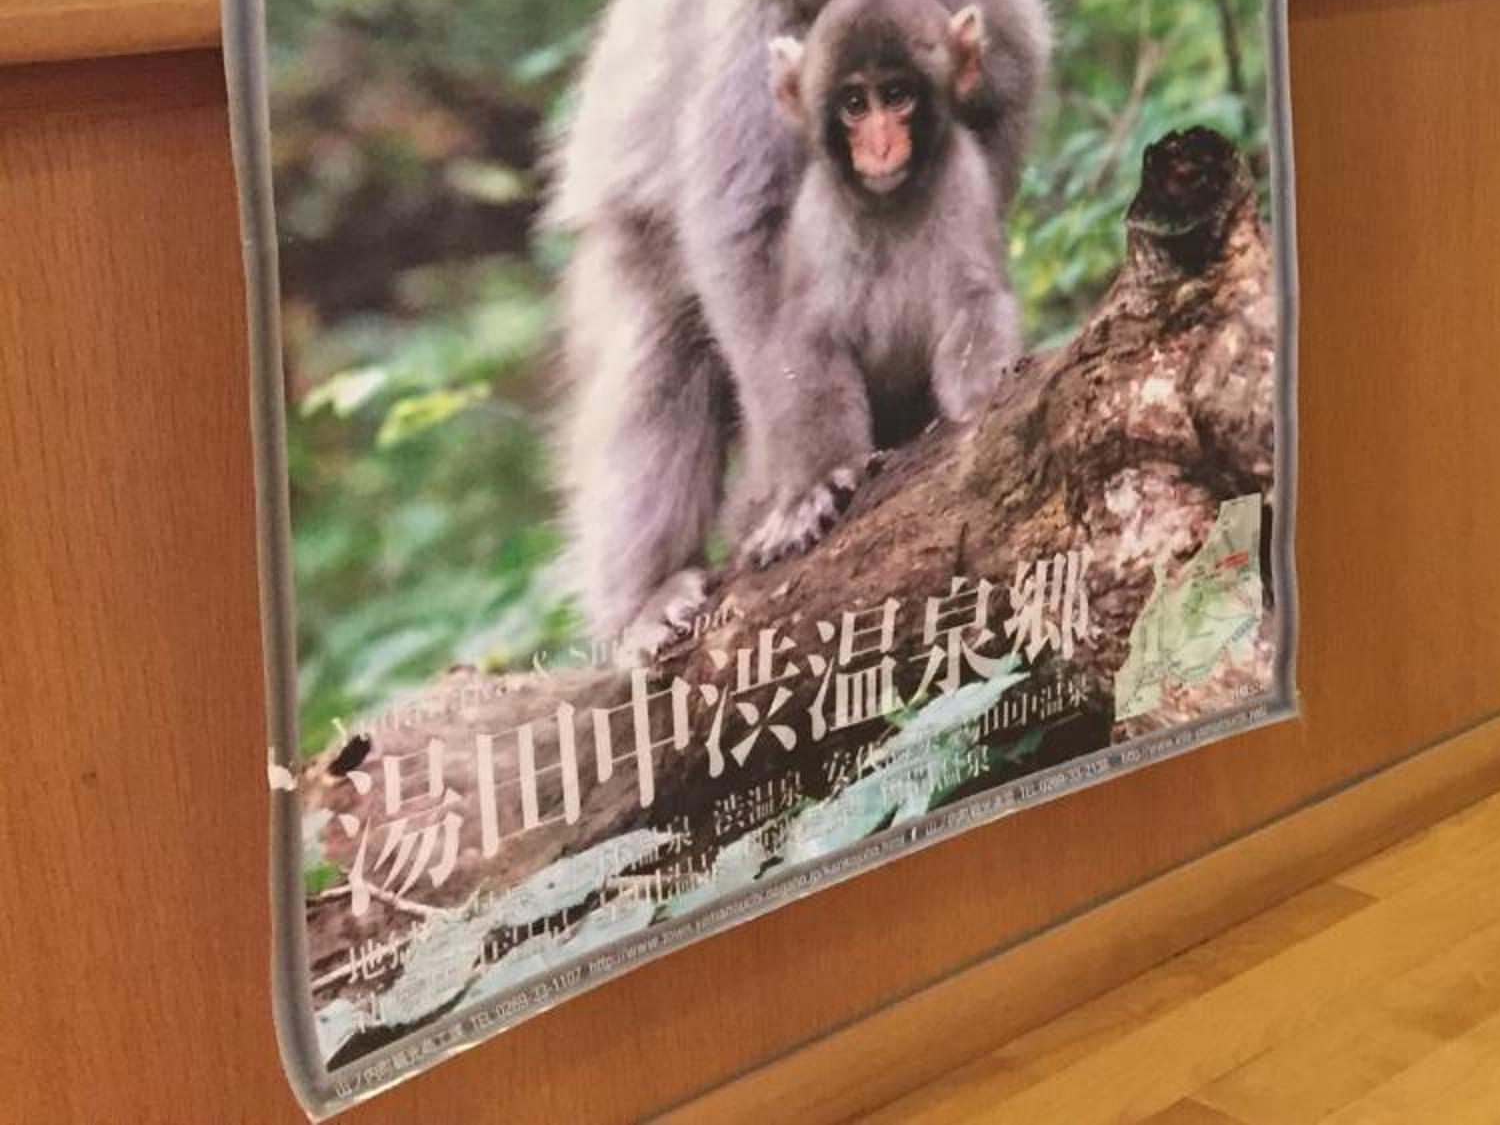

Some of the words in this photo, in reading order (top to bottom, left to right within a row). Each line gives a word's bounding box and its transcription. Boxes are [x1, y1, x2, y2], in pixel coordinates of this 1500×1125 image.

[336, 550, 1095, 916] 湯田中渋温泉郷
